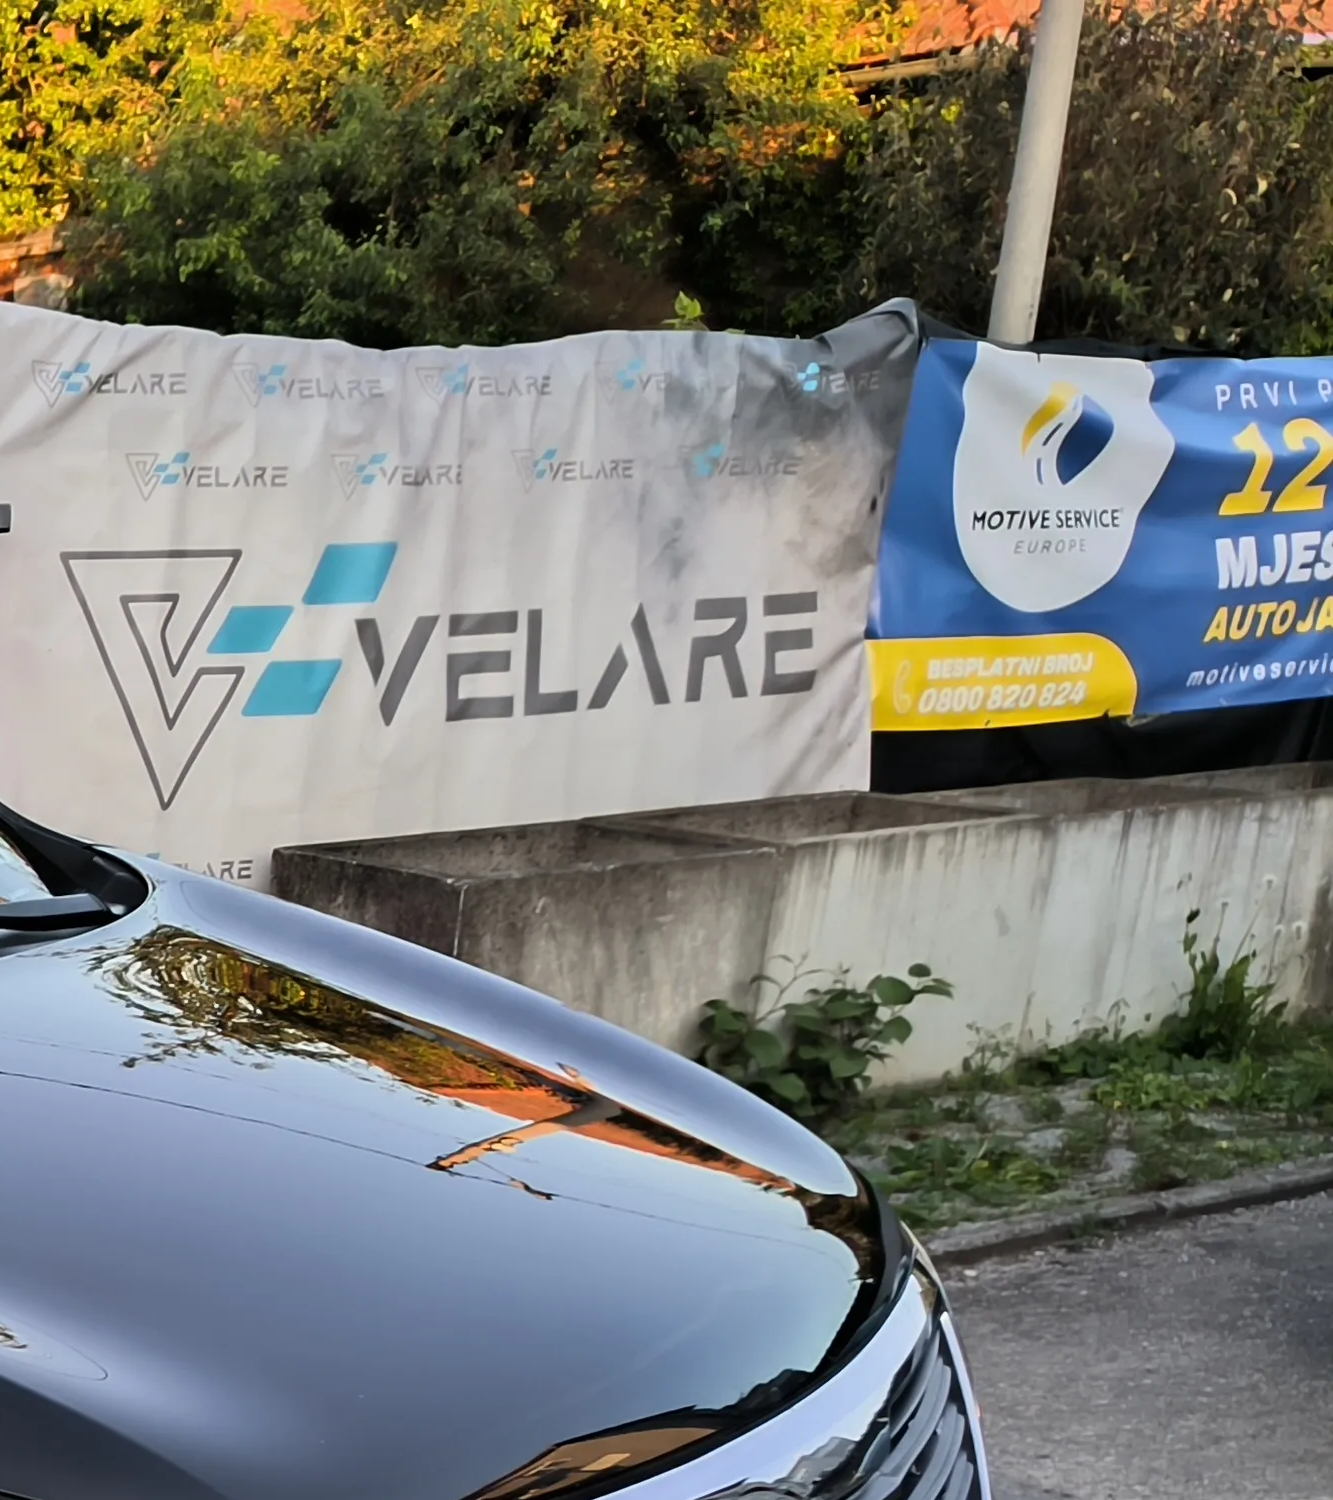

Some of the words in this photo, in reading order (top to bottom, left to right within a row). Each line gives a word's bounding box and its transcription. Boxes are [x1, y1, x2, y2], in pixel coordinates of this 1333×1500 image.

[86, 373, 188, 396] VELARE
[279, 377, 385, 401] VELARE
[465, 375, 553, 397] VELARE
[1215, 380, 1297, 411] PRVI
[182, 466, 289, 488] VELARE
[550, 459, 634, 483] VELARE
[1218, 417, 1333, 516] 12
[972, 509, 1051, 531] MOTIVE
[1055, 508, 1121, 530] SERVICE
[1013, 538, 1087, 555] EUROPE
[1203, 600, 1296, 643] AUTO
[354, 591, 819, 728] VELARE
[927, 656, 1041, 680] BESPLATNI
[1043, 652, 1094, 675] BROJ
[918, 686, 984, 714] 0800
[986, 683, 1037, 711] 820
